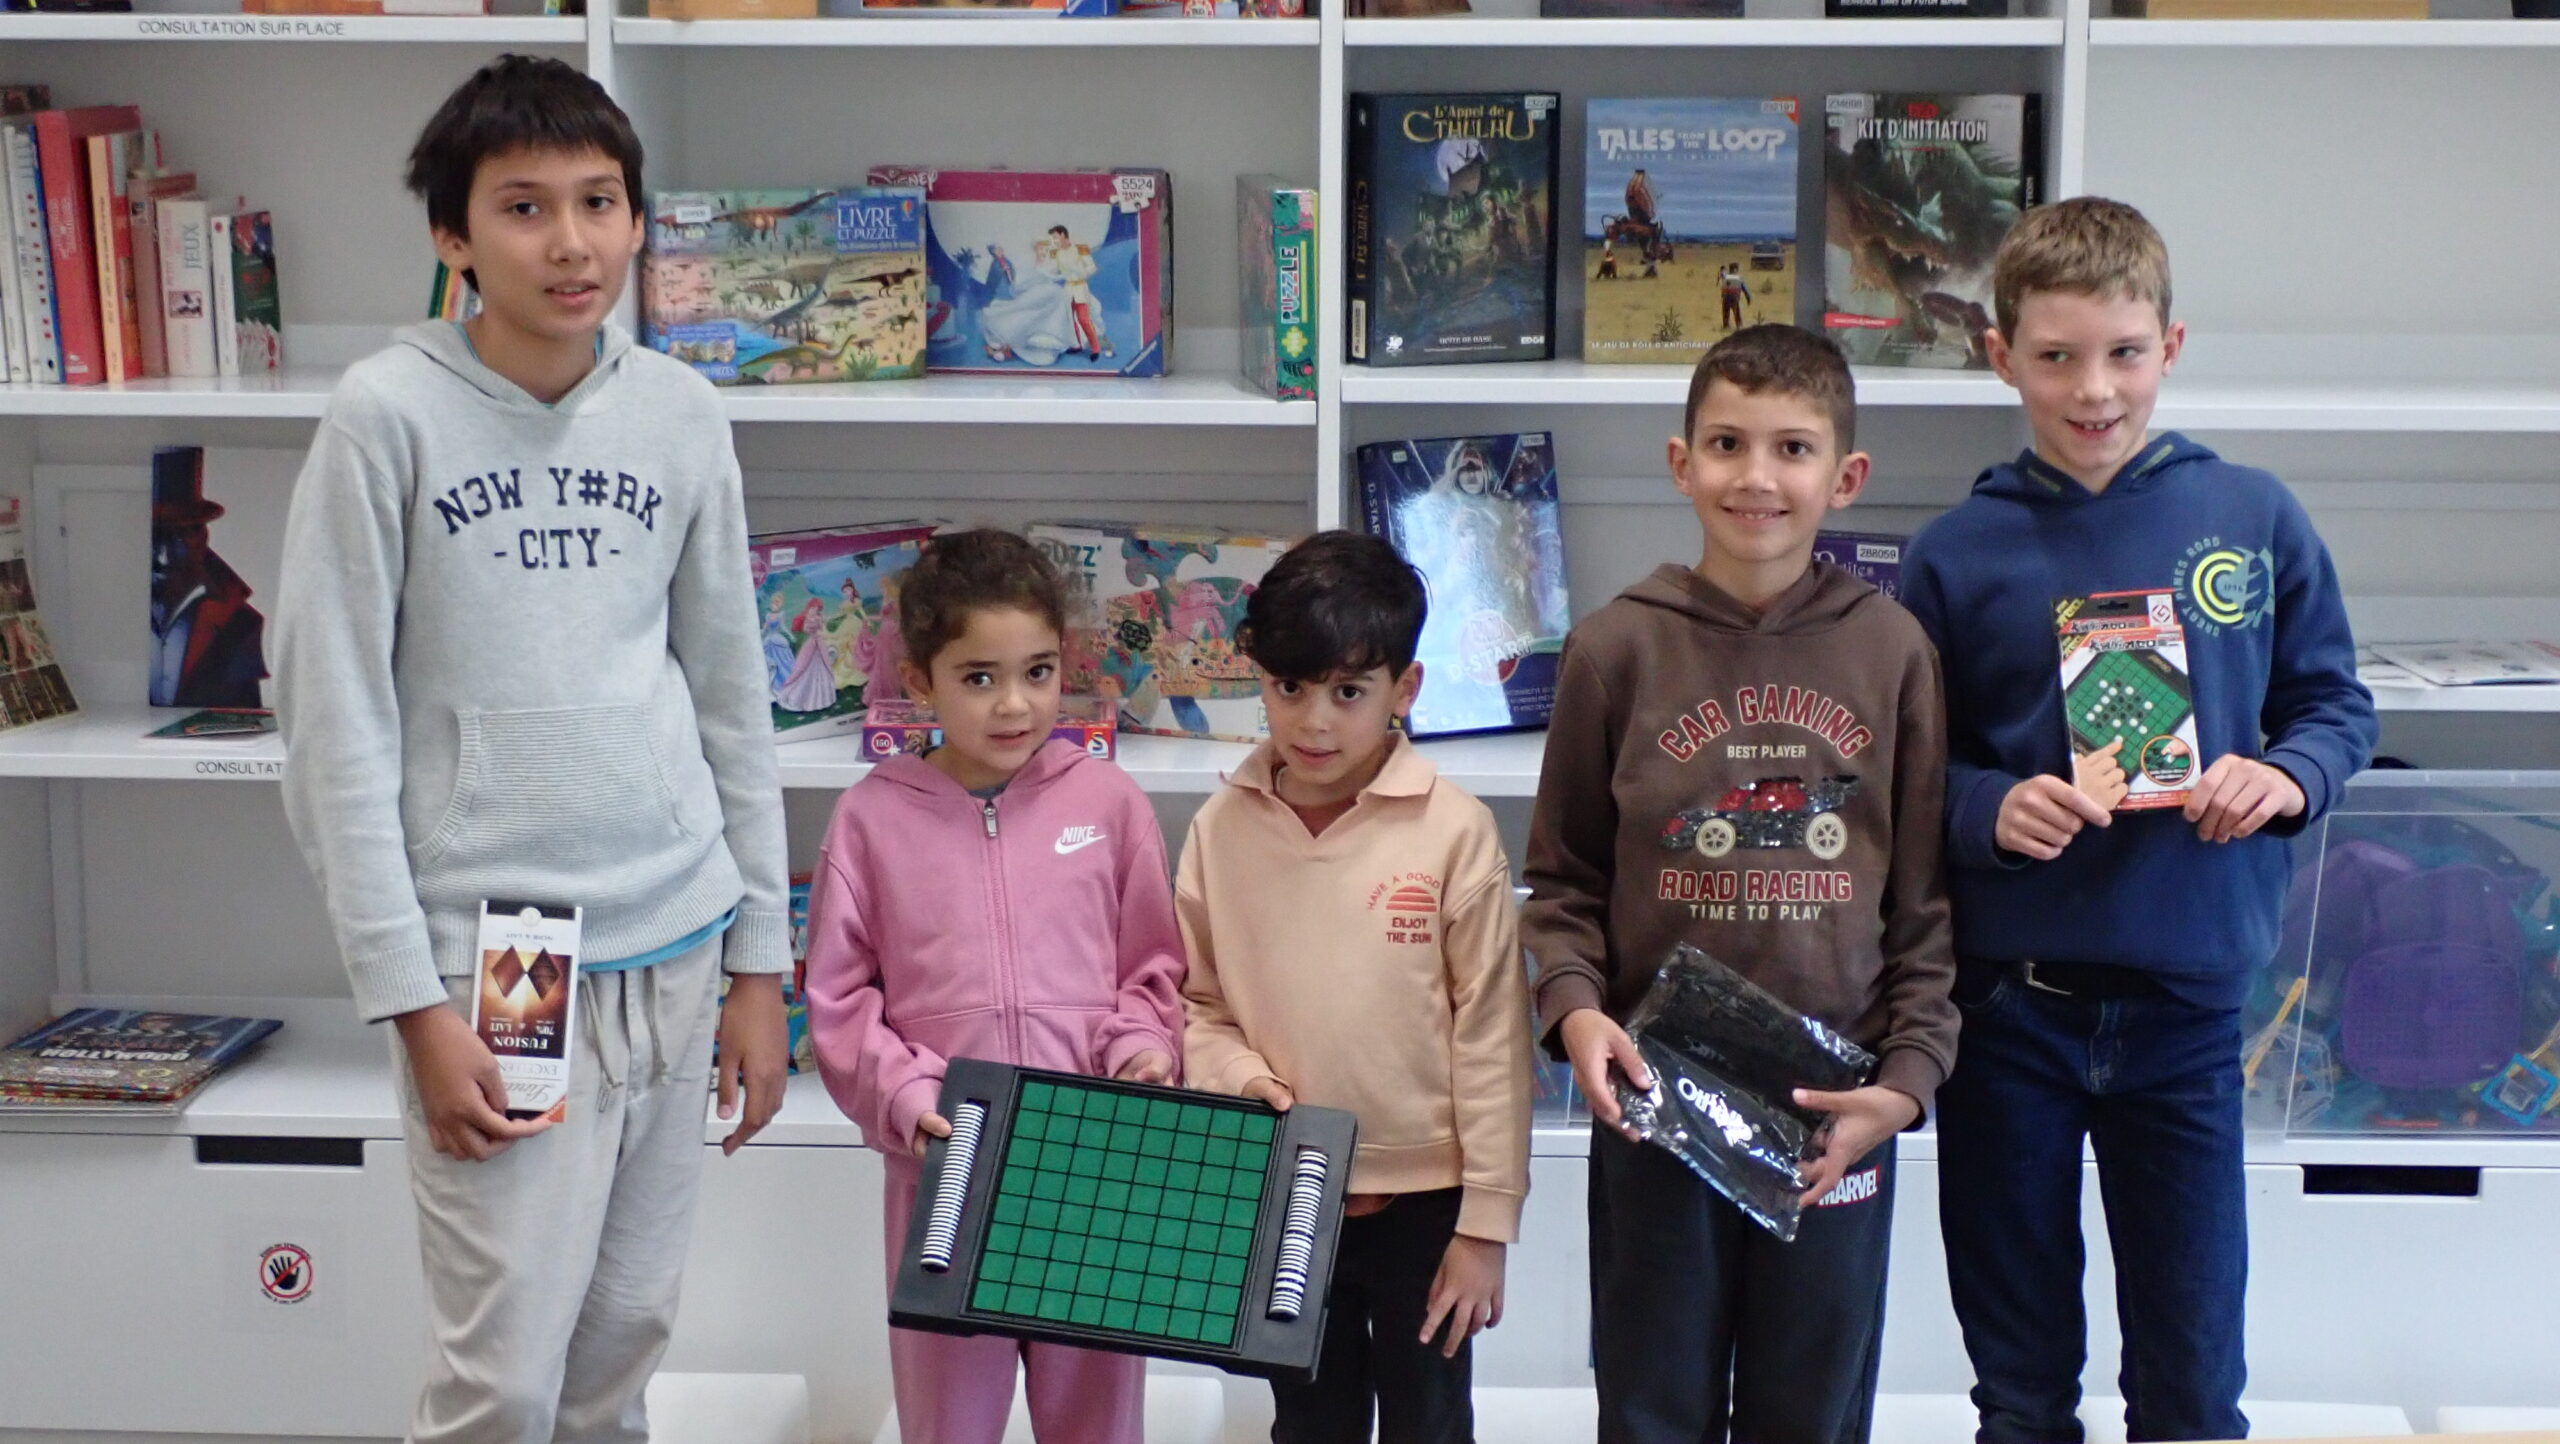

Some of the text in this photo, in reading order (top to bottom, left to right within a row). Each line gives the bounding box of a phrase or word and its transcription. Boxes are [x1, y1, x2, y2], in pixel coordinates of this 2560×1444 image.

[138, 20, 345, 36] CONSULTATION SUR PLACE
[1857, 119, 1988, 142] KIT D'INITIATION
[1597, 129, 1676, 160] TALES
[1708, 129, 1787, 160] LOOP
[1121, 178, 1153, 191] 5524
[837, 207, 898, 229] LIVRE
[1280, 246, 1300, 325] PUZZLE
[1520, 335, 1545, 345] EDGE
[433, 468, 524, 535] N3W
[1657, 684, 1873, 763] CAR GAMING
[1726, 744, 1807, 759] BEST PLAYER
[195, 761, 284, 775] CONSULTAT
[1061, 825, 1096, 844] NIKE
[1366, 872, 1441, 912] HAVE A GOOD
[1658, 868, 1853, 902] ROAD RACING
[1689, 904, 1822, 921] TIME TO PLAY
[1392, 917, 1428, 929] ENJOY
[1386, 932, 1433, 944] THE SUN
[489, 1022, 513, 1033] LAIT
[493, 1036, 549, 1050] FUSION
[39, 1048, 191, 1062] HOLLYWOOD
